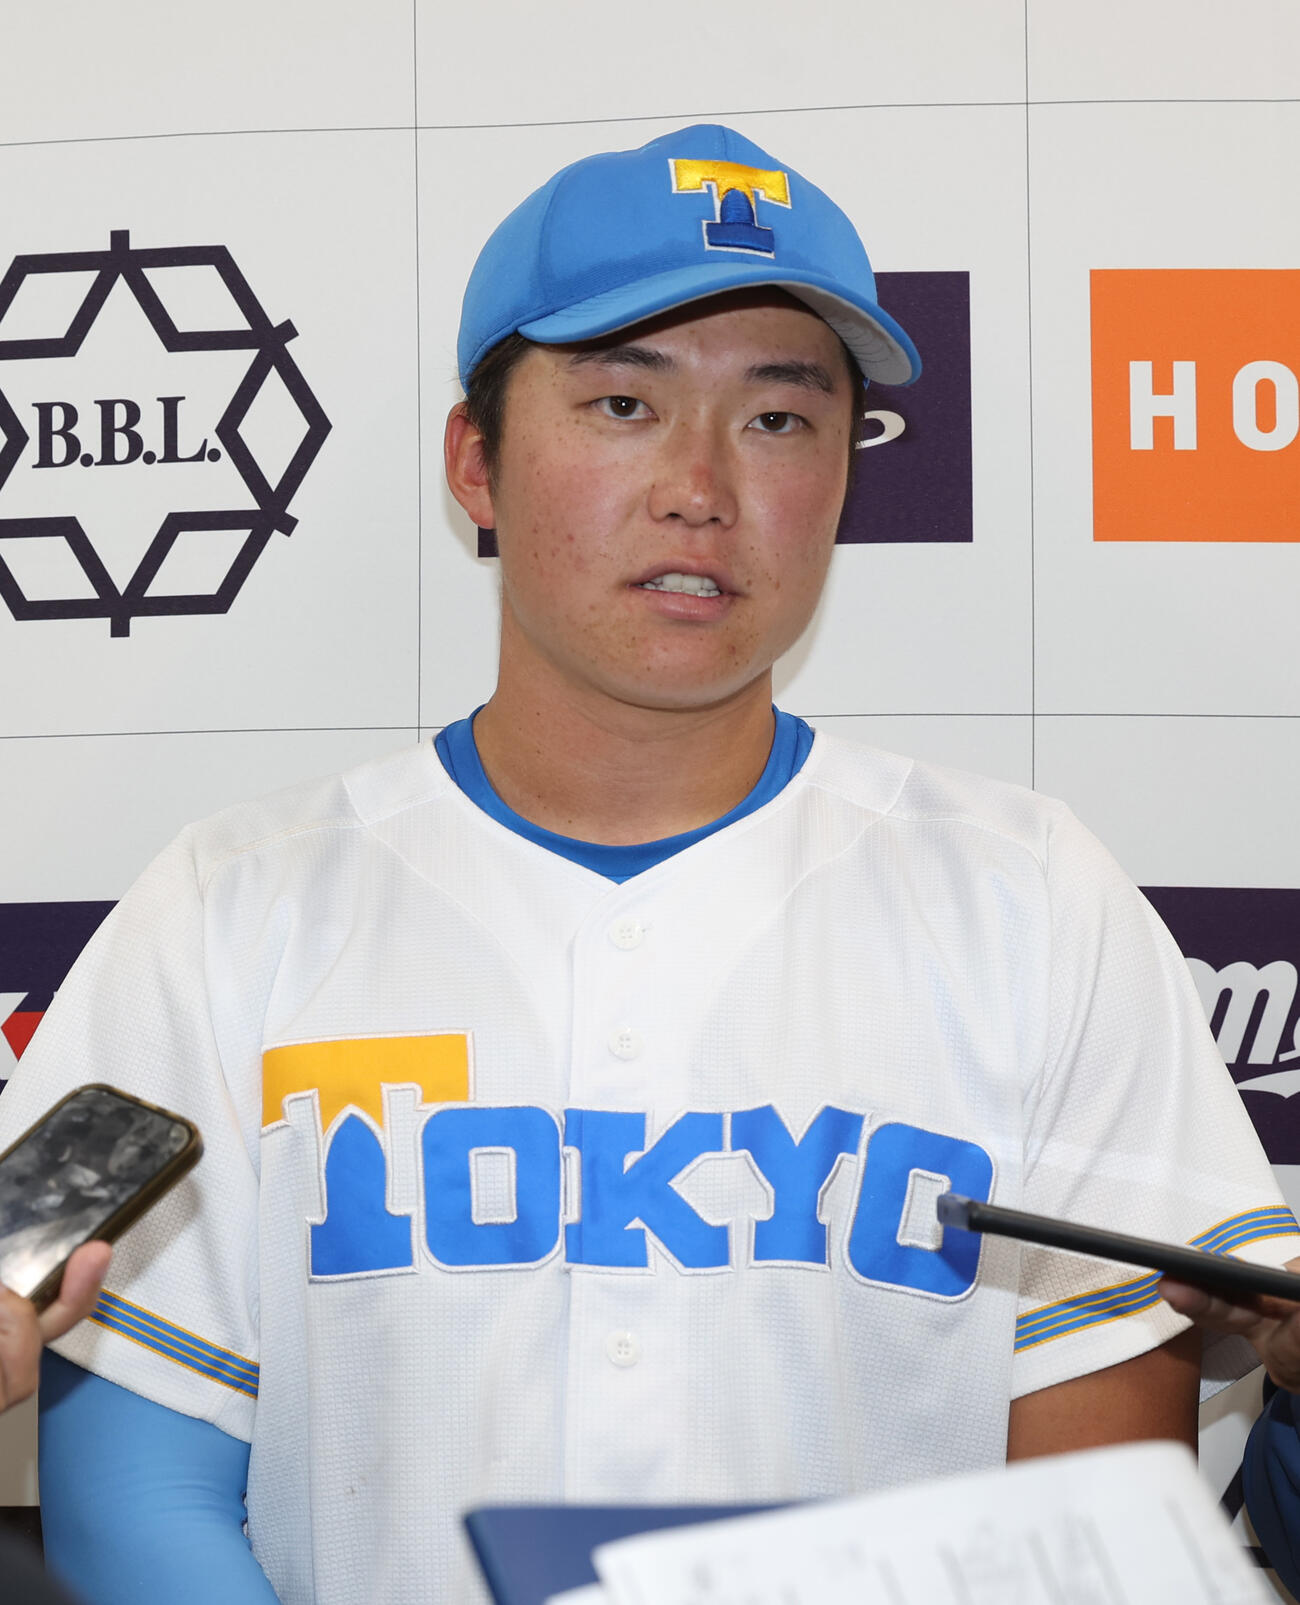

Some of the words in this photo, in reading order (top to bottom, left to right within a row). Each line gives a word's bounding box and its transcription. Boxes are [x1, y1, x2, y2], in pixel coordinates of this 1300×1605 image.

[668, 158, 792, 259] T
[31, 396, 221, 468] B.B.L.
[261, 1028, 996, 1304] TOKYO
